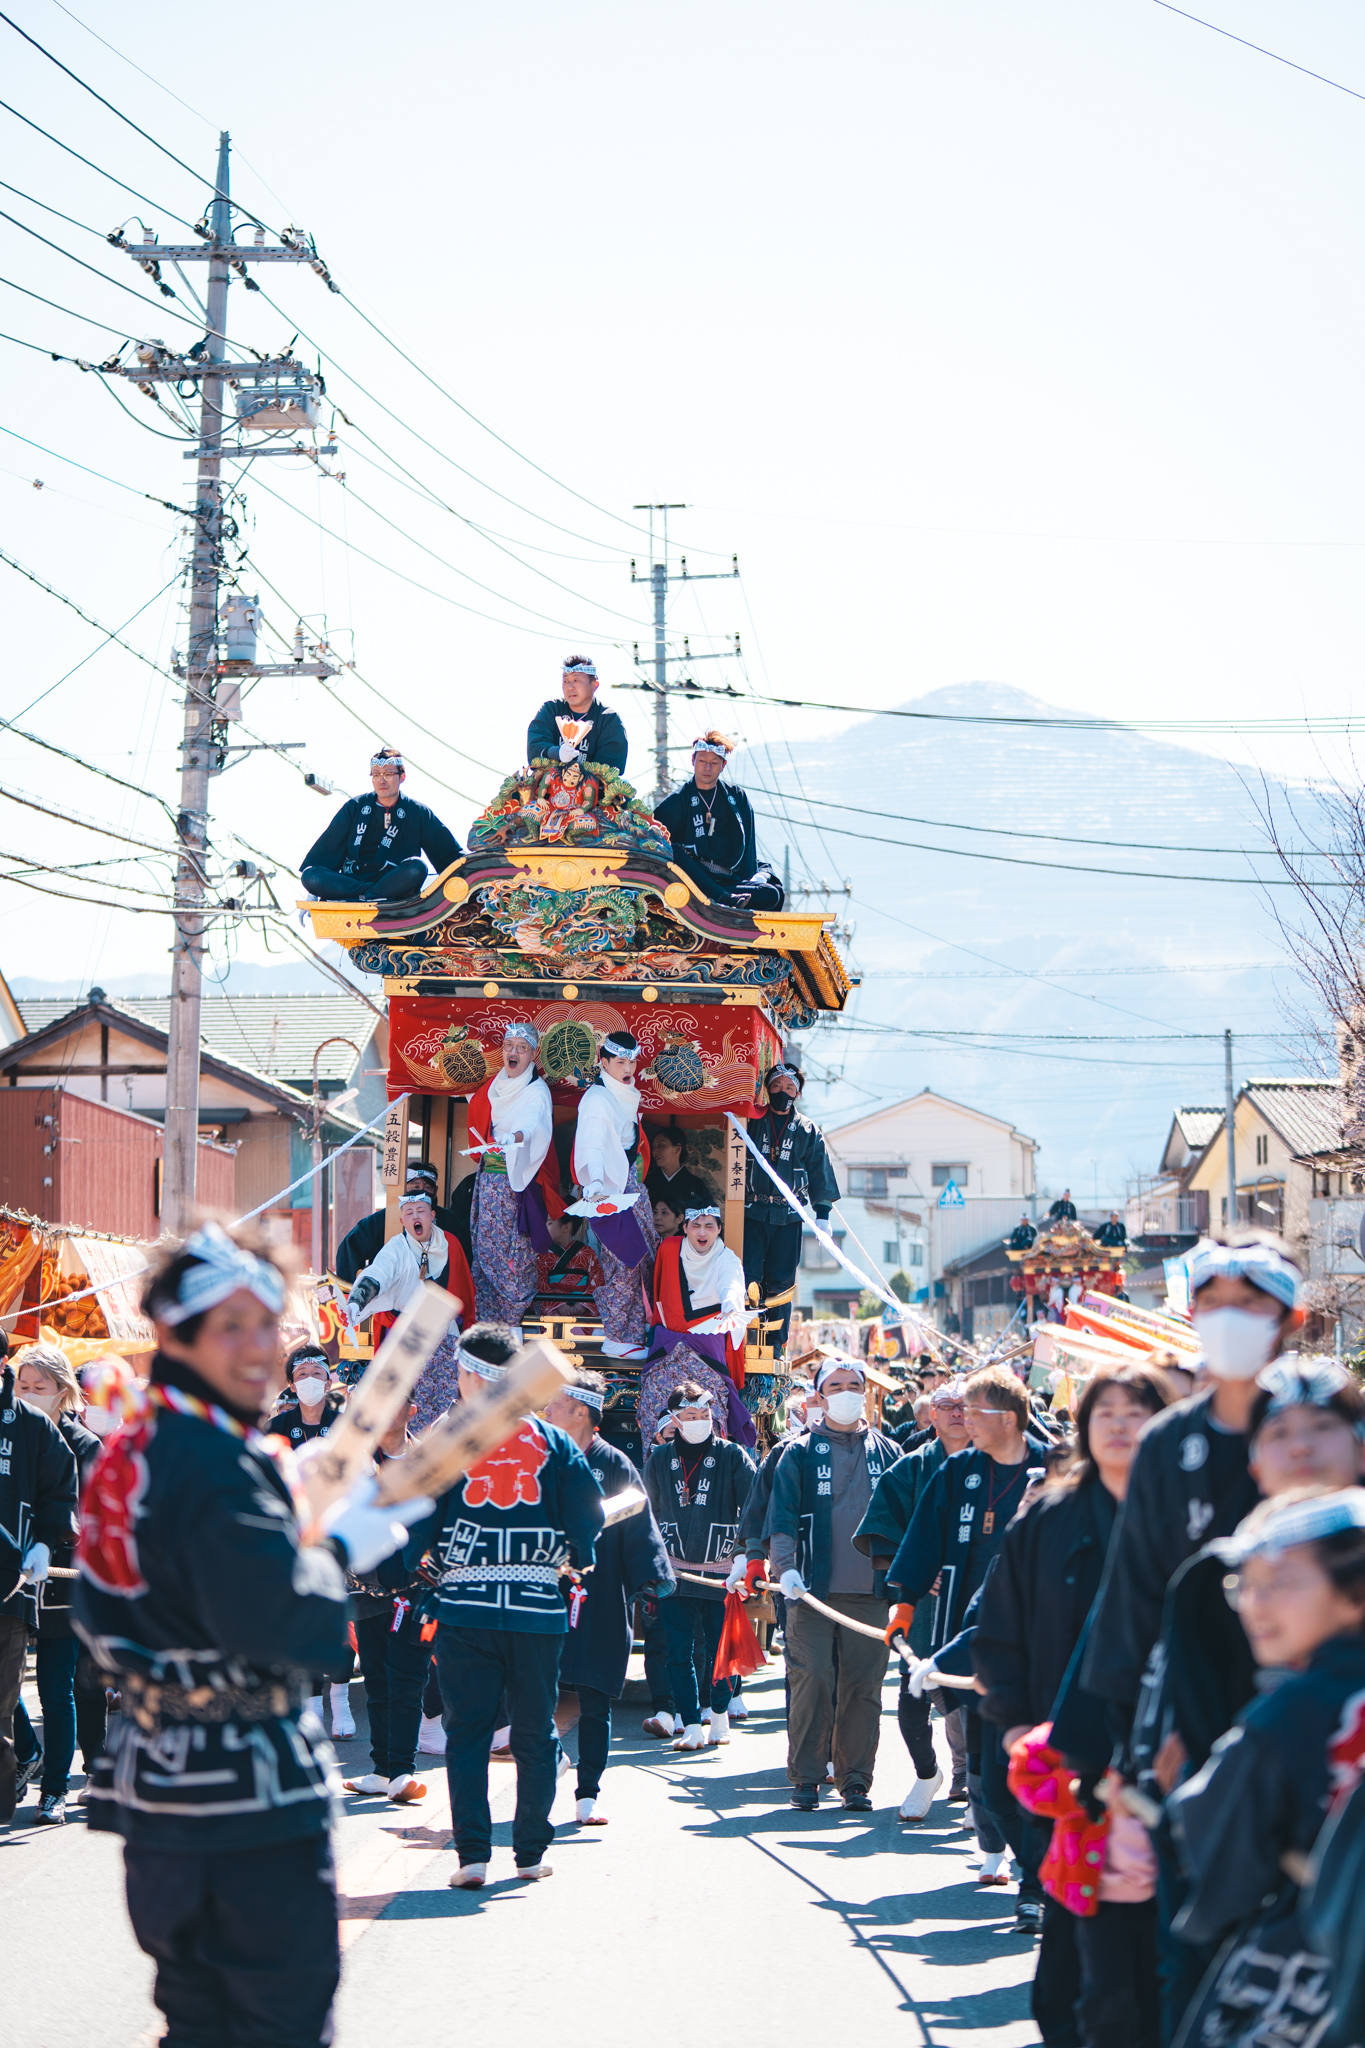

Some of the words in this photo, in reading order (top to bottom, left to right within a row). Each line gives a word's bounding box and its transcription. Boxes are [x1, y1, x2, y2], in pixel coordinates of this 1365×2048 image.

[380, 815, 399, 849] 山組
[692, 813, 705, 838] 山組
[730, 1127, 744, 1191] 天下泰平
[779, 1138, 793, 1162] 山組
[694, 1477, 710, 1506] 山組
[817, 1464, 832, 1496] 山組
[957, 1502, 975, 1544] 山組
